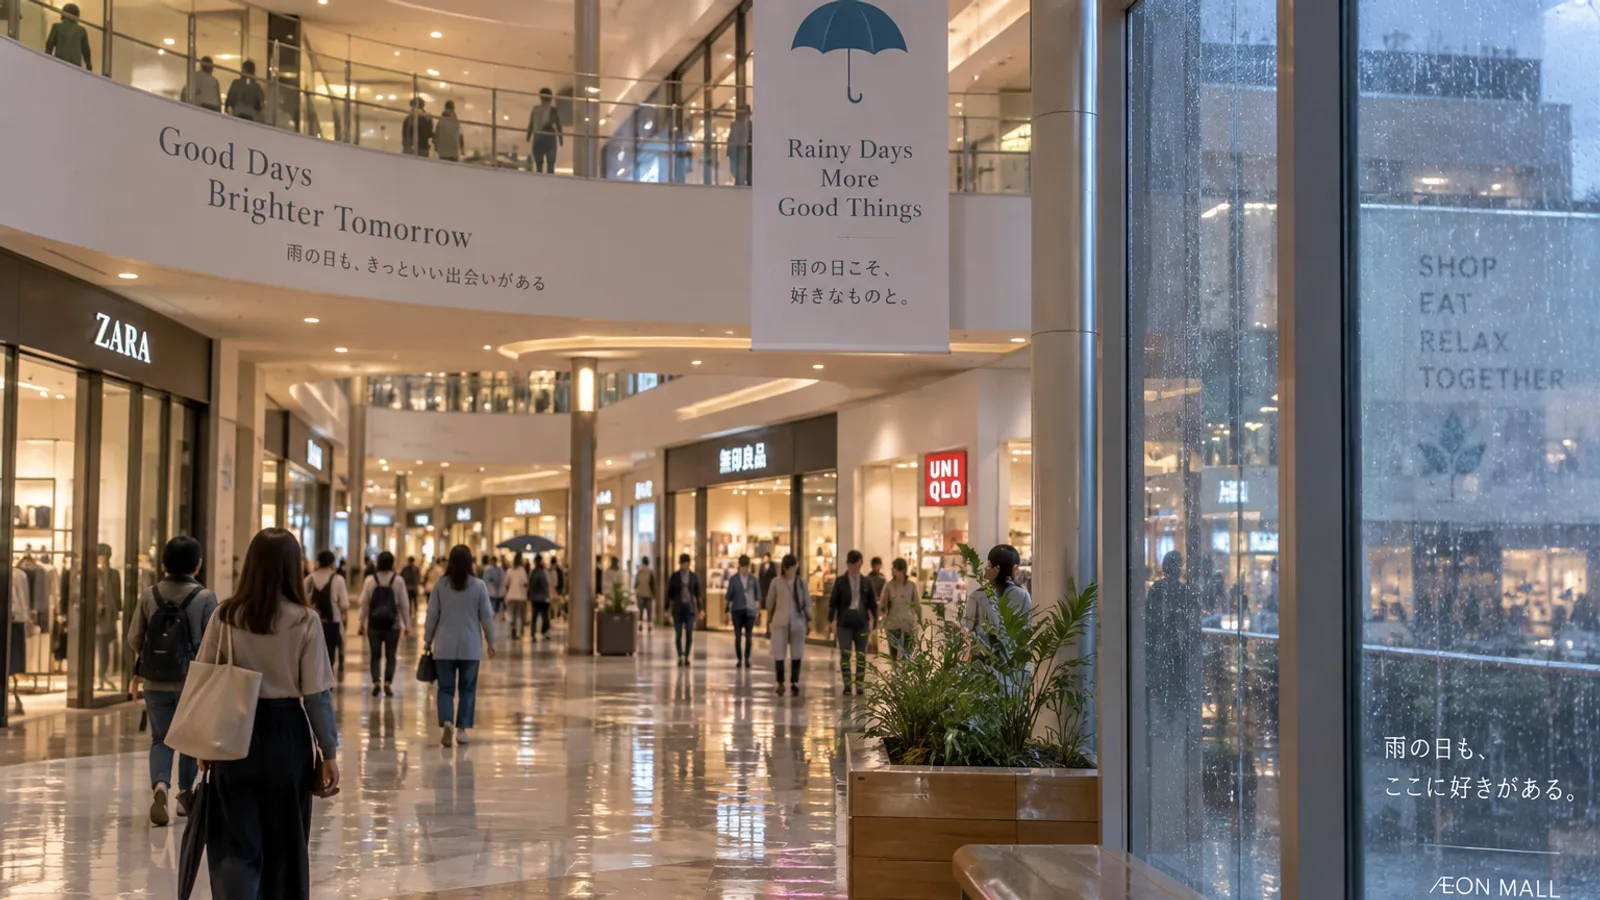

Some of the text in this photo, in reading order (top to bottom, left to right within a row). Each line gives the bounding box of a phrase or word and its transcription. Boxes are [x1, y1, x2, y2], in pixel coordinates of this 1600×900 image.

[158, 126, 313, 190] Good Days
[787, 138, 914, 165] Rainy Days
[820, 168, 880, 188] More
[207, 178, 473, 249] Brighter Tomorrow
[777, 197, 923, 224] Good Things
[286, 243, 546, 293] 雨の日も、きっといい出会いがある
[790, 258, 891, 277] 雨の日こそ、
[1418, 254, 1498, 279] SHOP
[790, 286, 909, 306] 好きなものと。
[1419, 292, 1473, 315] EAT
[94, 312, 151, 364] ZARA
[1419, 330, 1510, 354] RELAX
[1418, 366, 1565, 391] TOGETHER
[719, 442, 767, 475] 無印良品
[929, 459, 959, 480] UNI
[929, 480, 962, 503] QLO
[1384, 735, 1486, 761] 雨の日も、
[1385, 775, 1575, 803] ここに好きがある。
[1499, 878, 1561, 898] MALL
